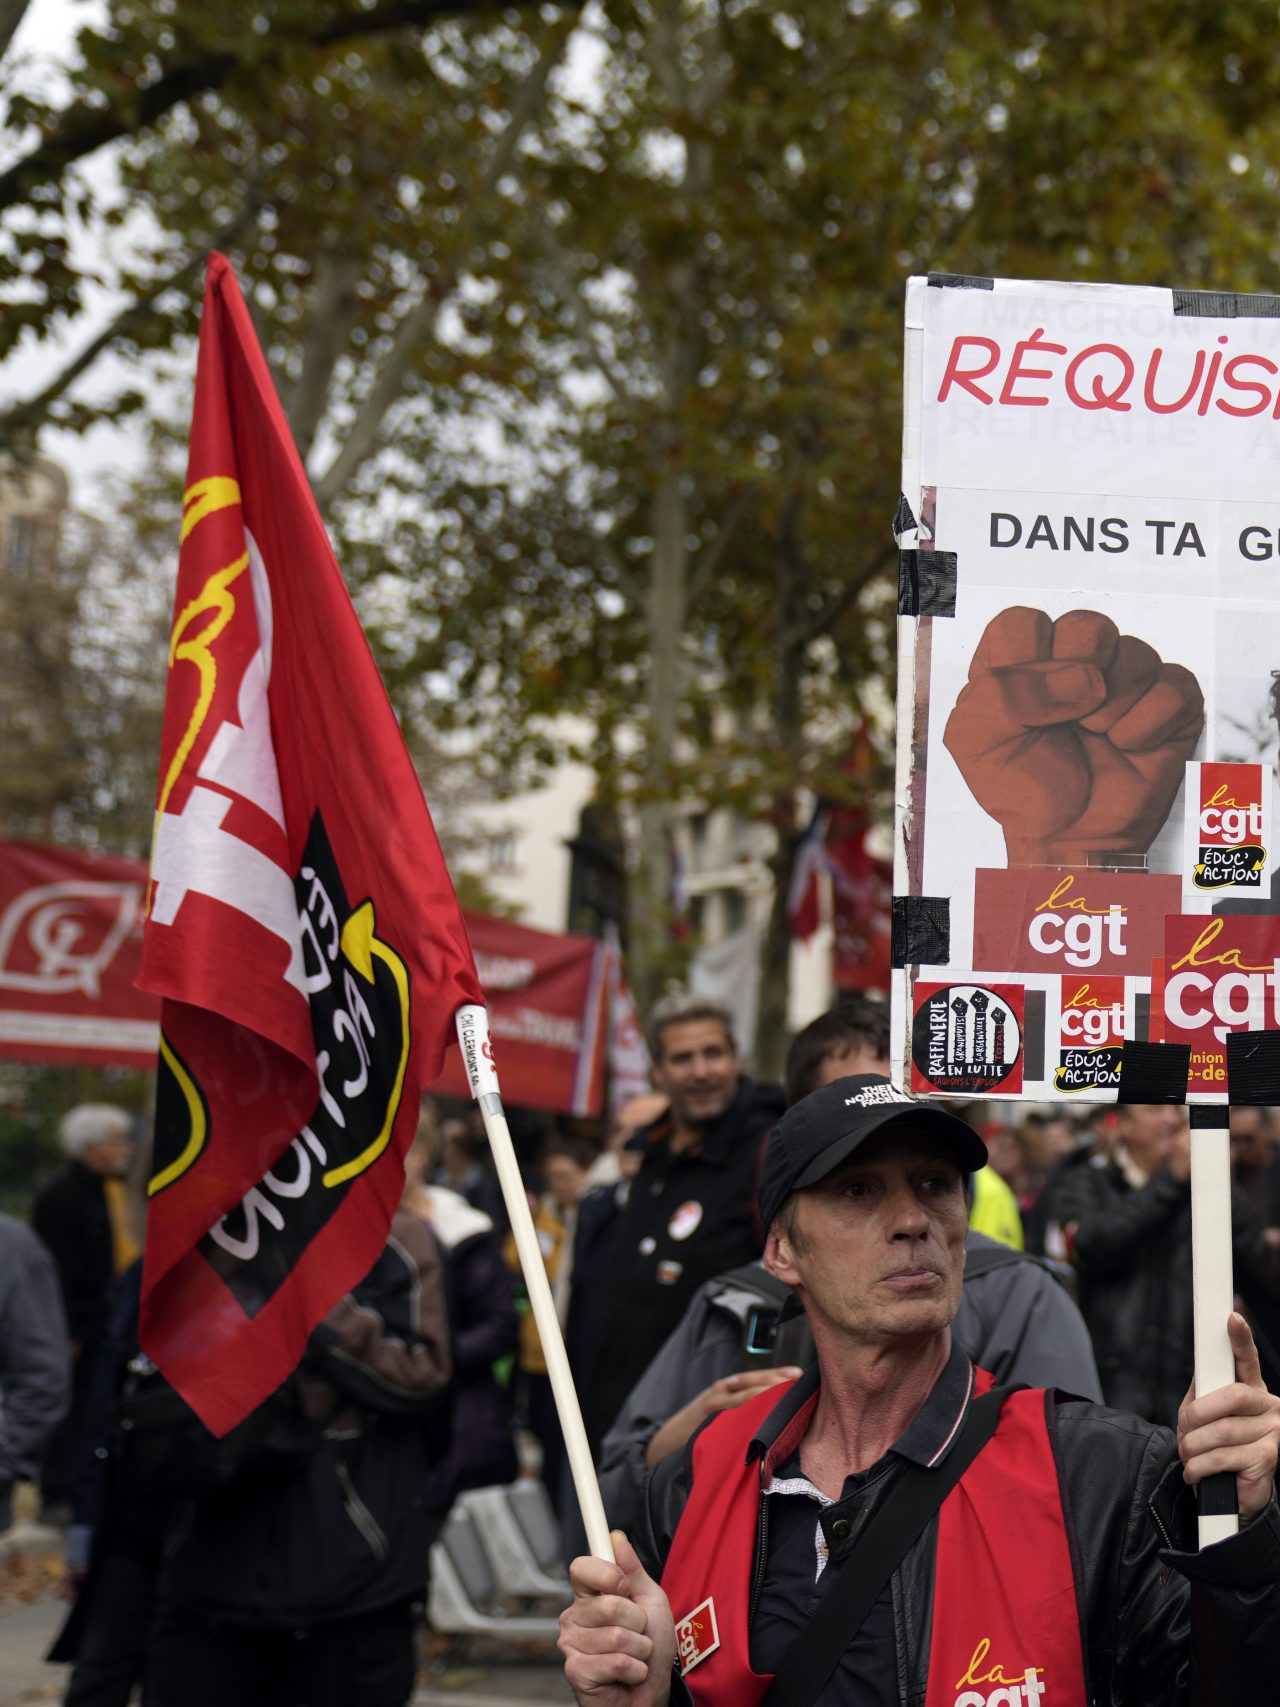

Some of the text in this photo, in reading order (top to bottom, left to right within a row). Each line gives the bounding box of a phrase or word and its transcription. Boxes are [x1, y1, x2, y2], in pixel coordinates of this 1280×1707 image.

[988, 512, 1130, 554] DANS
[1145, 520, 1206, 558] TA
[1203, 784, 1263, 809] la
[1200, 803, 1263, 844] cgt
[1035, 875, 1128, 913] la
[1028, 904, 1128, 968] cgt
[1064, 984, 1125, 1009] la
[928, 1001, 948, 1076] RAFFINERIE
[1060, 1003, 1125, 1045] cgt
[860, 1085, 887, 1093] THE
[948, 1064, 1003, 1077] EN LUTTE
[844, 1091, 890, 1106] NORTH
[861, 1097, 894, 1108] FACE
[680, 1621, 700, 1666] cgt
[955, 1637, 1044, 1690] la
